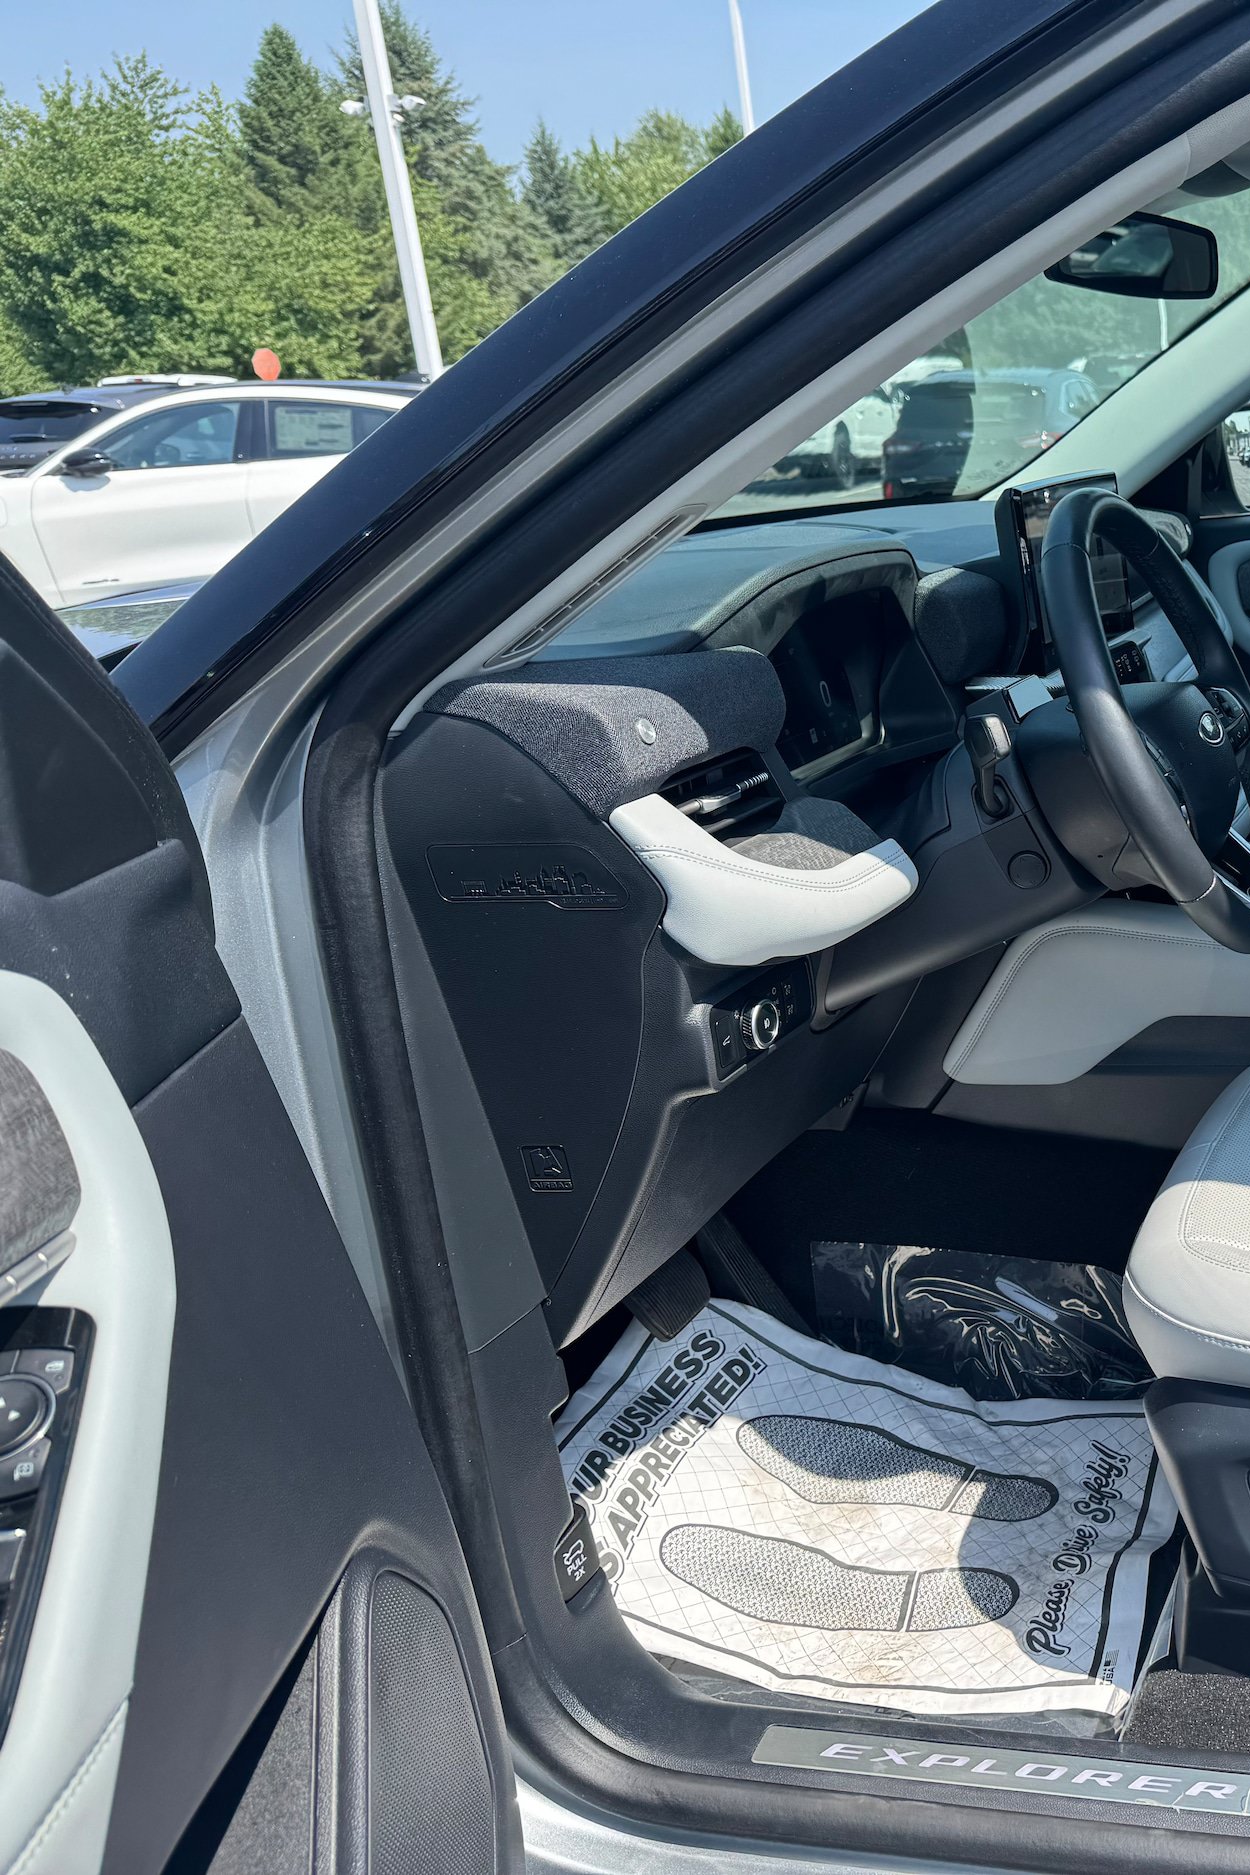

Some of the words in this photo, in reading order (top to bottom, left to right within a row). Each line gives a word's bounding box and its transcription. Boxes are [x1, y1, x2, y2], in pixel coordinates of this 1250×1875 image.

[598, 1331, 723, 1458] BUSINESS
[607, 1347, 764, 1553] APPRECIATED!
[566, 1553, 587, 1576] PULL
[574, 1565, 586, 1581] 2X
[1024, 1579, 1073, 1657] Please
[1073, 1440, 1130, 1524] Safely!
[819, 1742, 1244, 1799] EXPLORER
